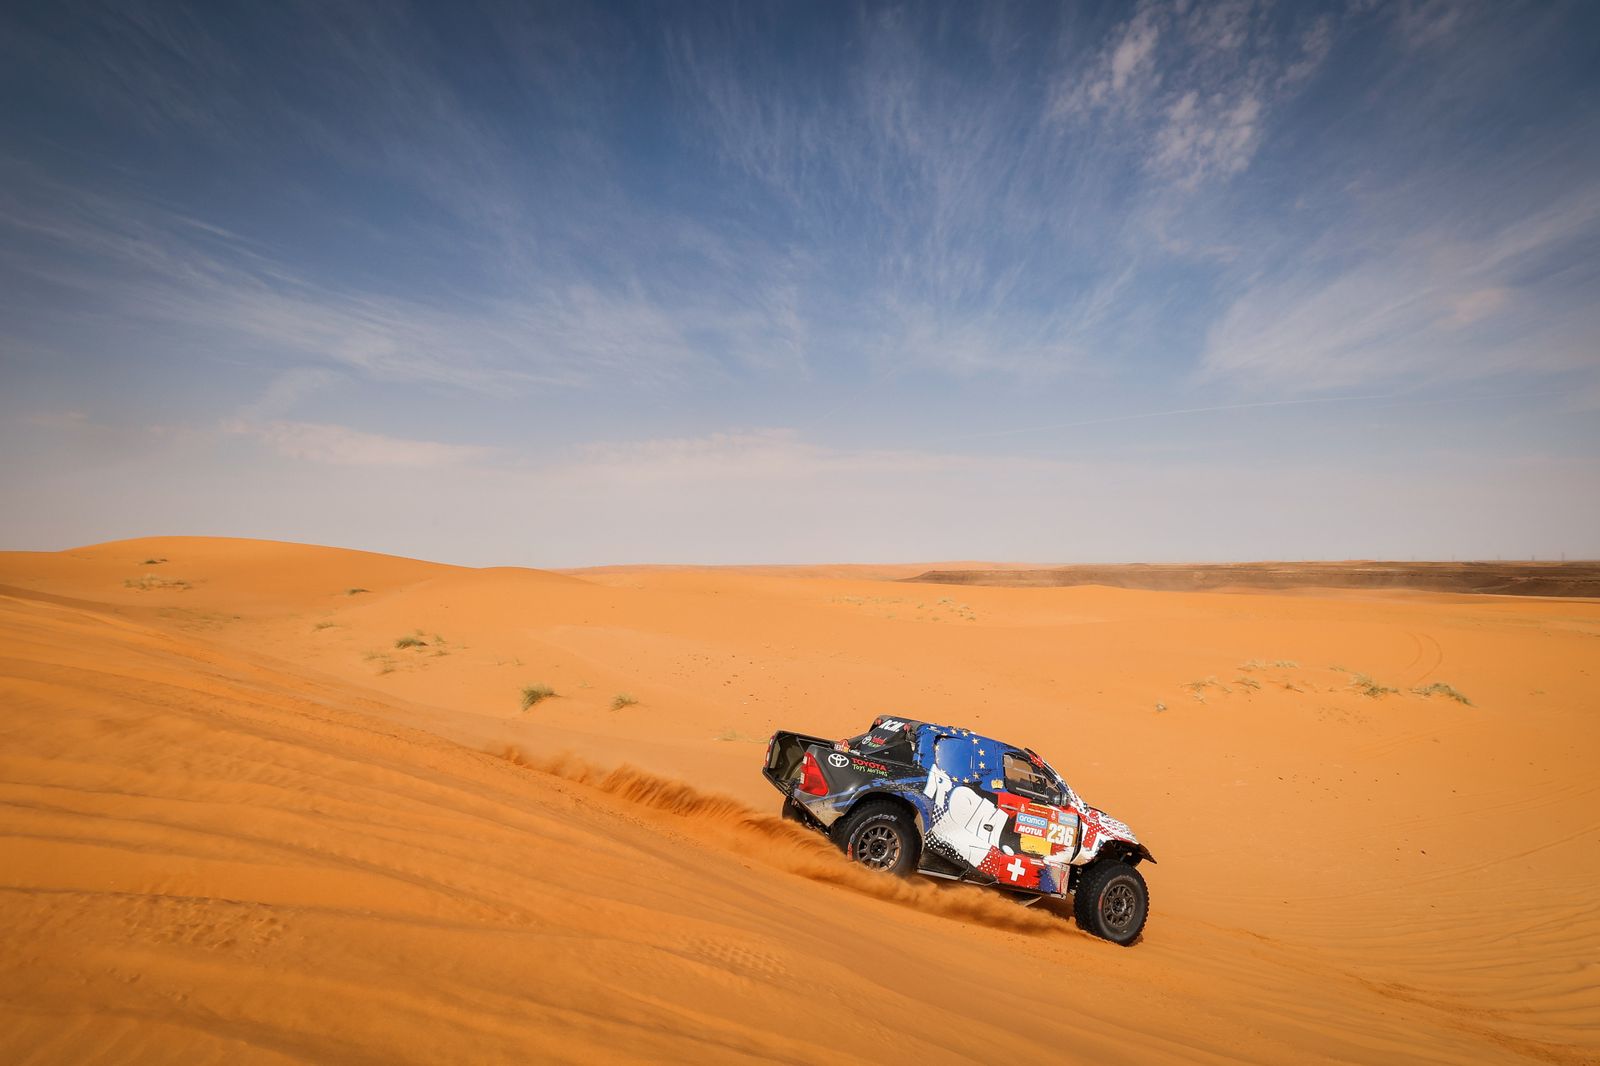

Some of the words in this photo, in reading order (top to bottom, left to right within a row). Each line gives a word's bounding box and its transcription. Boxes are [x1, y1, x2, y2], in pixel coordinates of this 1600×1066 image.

[851, 757, 888, 772] TOYOTA
[1019, 815, 1046, 826] aramco
[1017, 825, 1043, 837] MOTUL
[1046, 823, 1075, 847] 236
